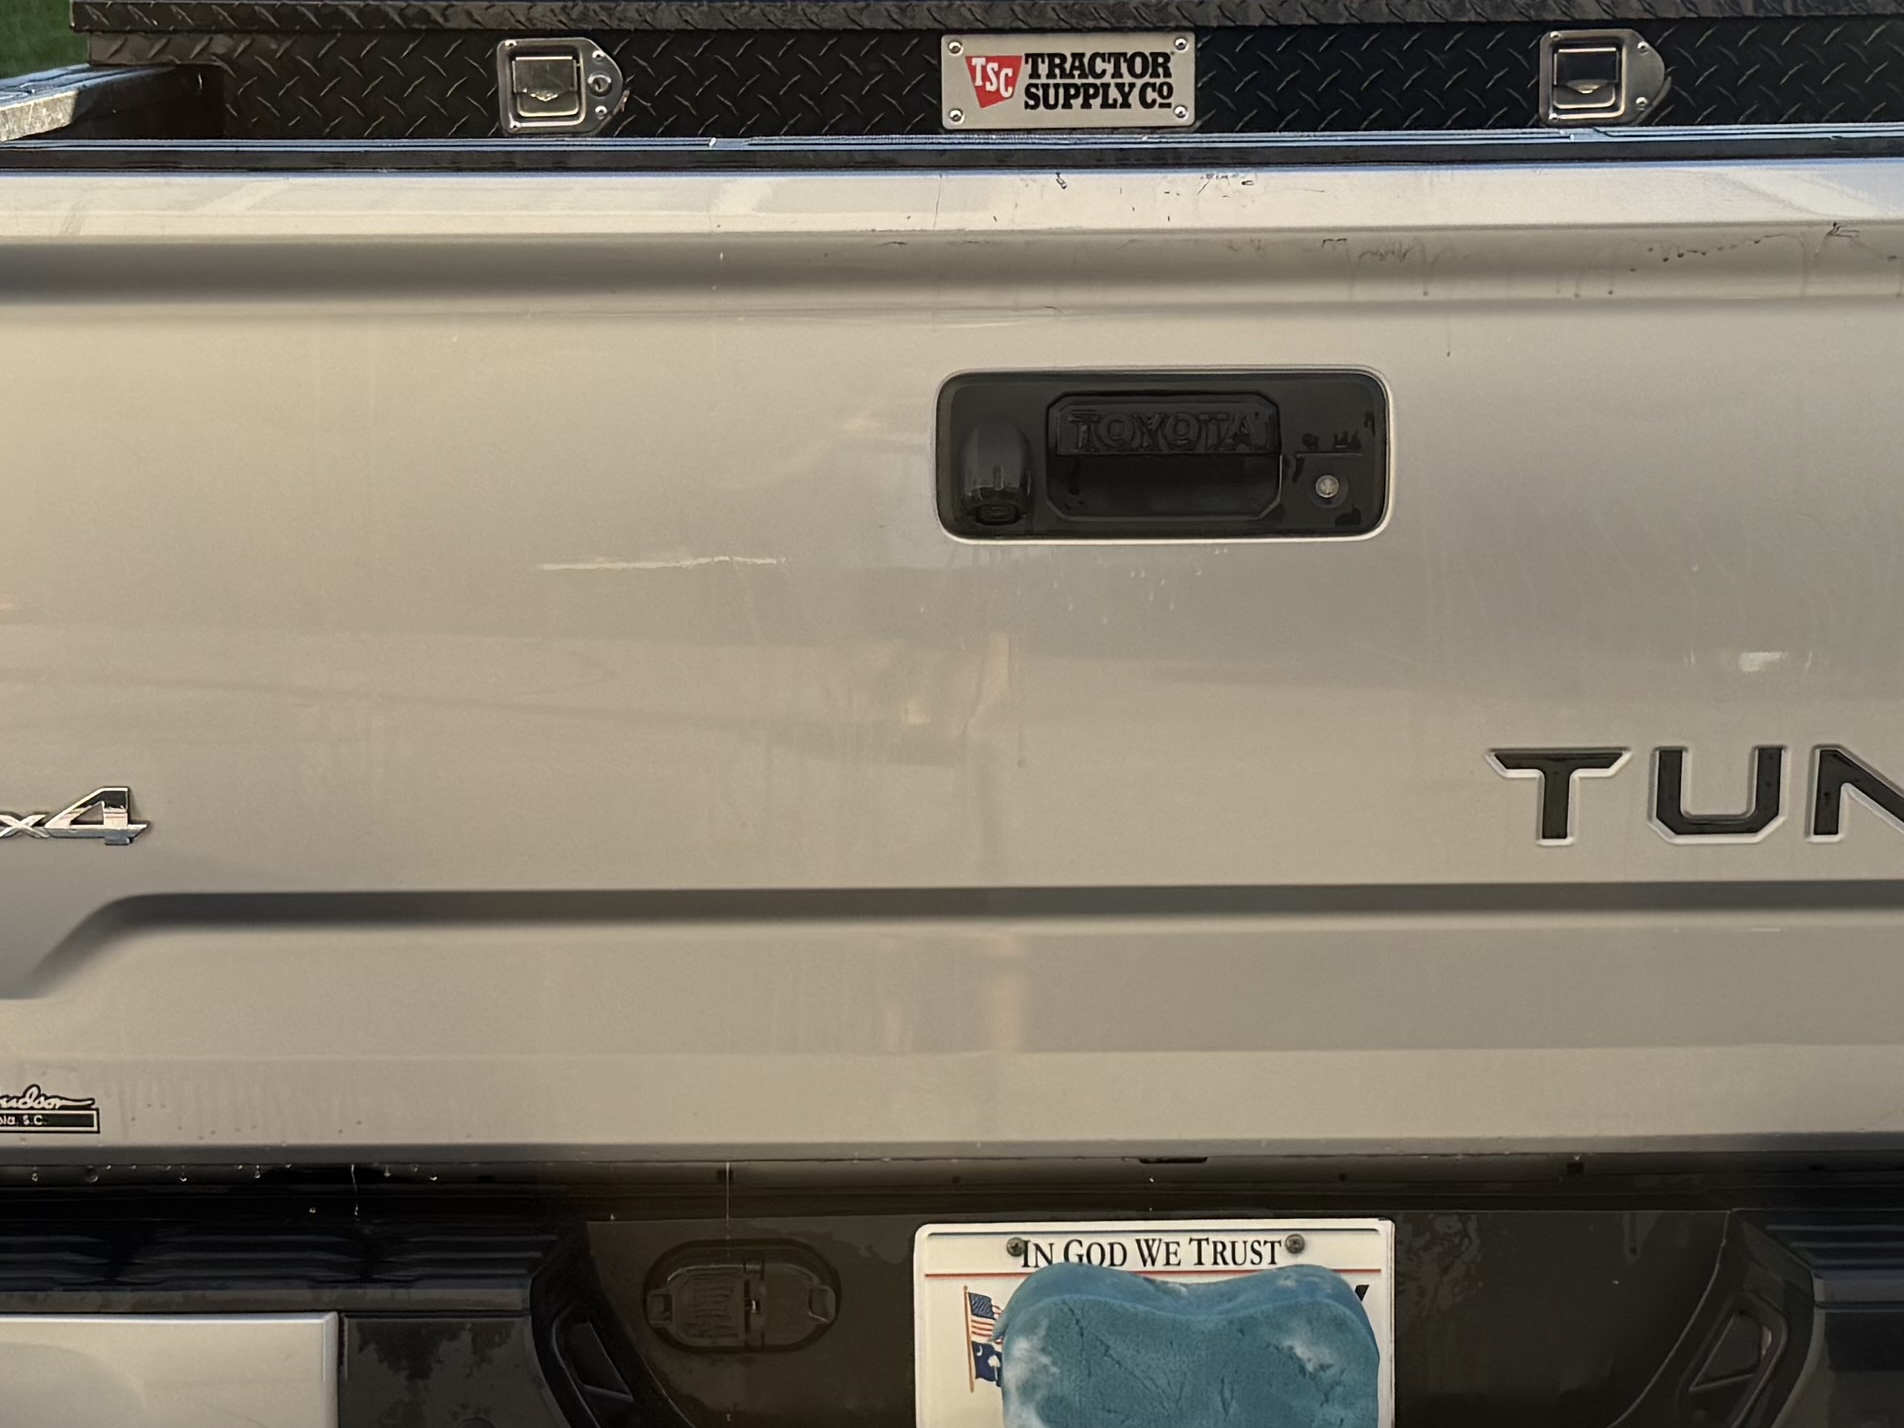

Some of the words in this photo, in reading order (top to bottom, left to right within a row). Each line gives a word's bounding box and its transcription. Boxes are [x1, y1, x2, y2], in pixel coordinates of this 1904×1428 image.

[970, 56, 1014, 99] TSC
[1024, 52, 1173, 80] TRACTOR
[1024, 82, 1134, 111] SUPPLY
[1068, 411, 1263, 453] TOYOTA
[1020, 1239, 1054, 1269] IN
[1062, 1238, 1128, 1268] GOD
[1134, 1238, 1182, 1268] WE
[1188, 1236, 1283, 1267] TRUST
